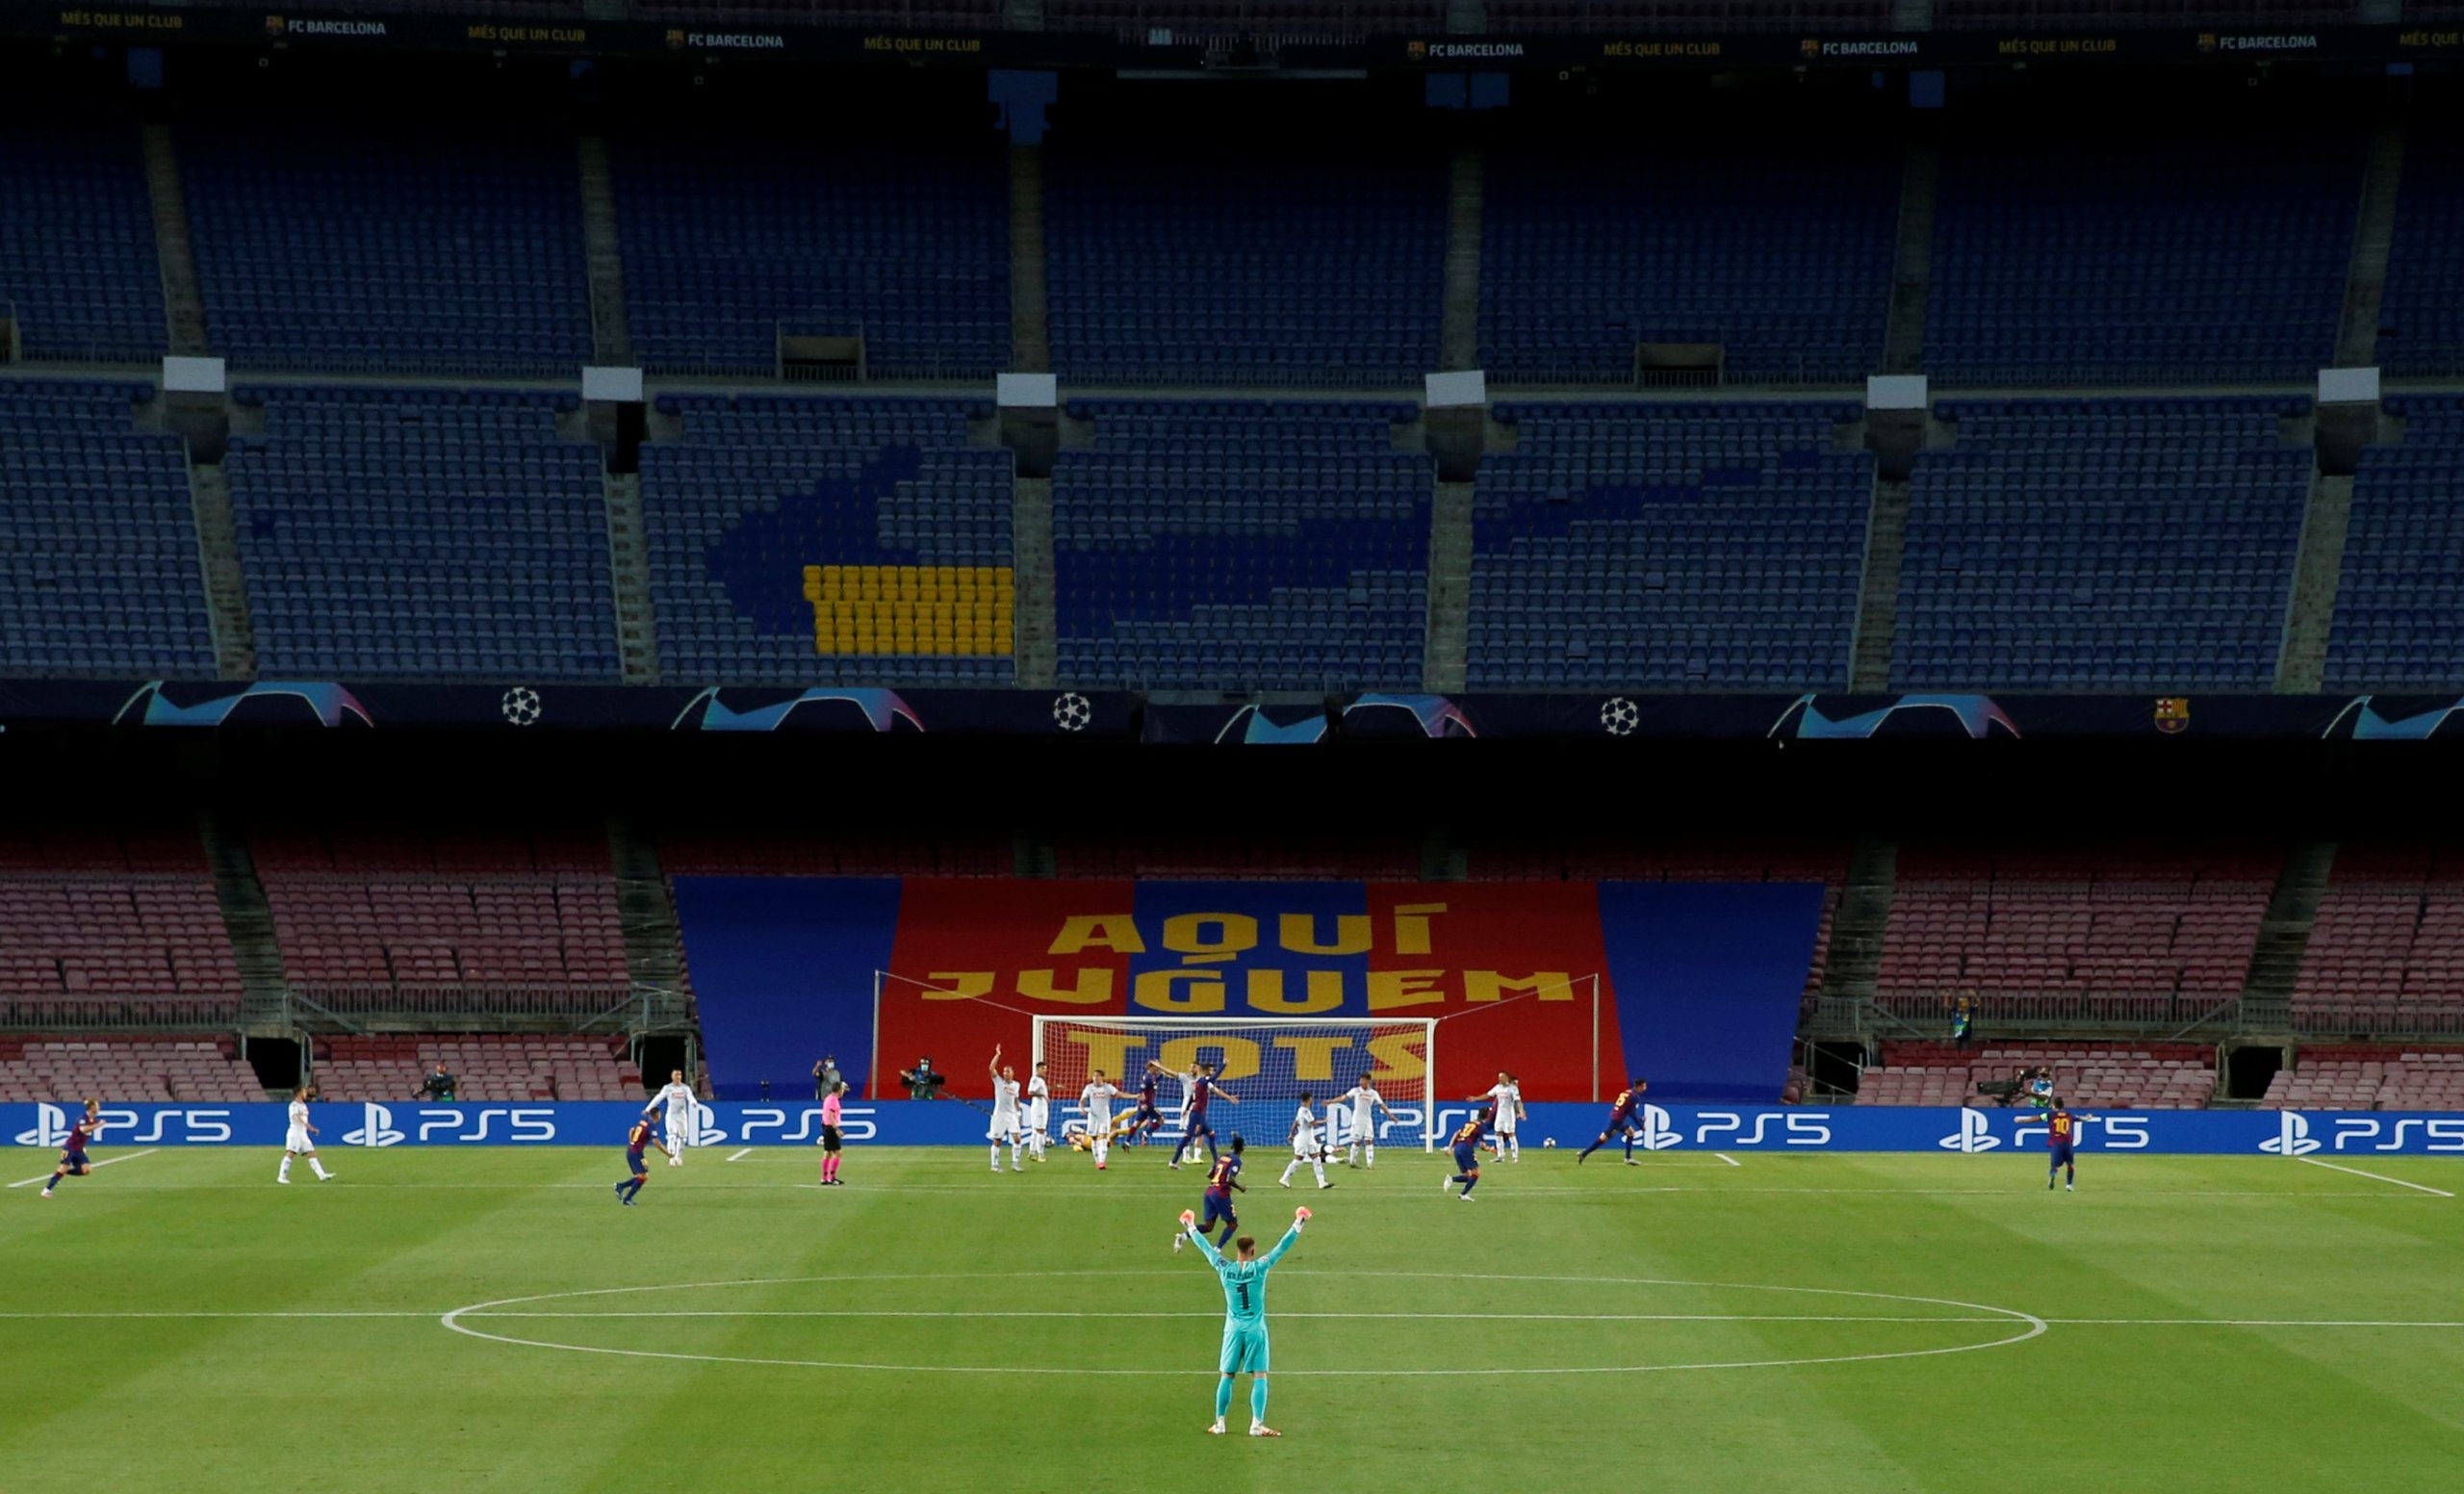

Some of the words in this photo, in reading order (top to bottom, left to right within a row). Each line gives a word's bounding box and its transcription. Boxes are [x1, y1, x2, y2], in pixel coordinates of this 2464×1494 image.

[62, 10, 91, 26] MÉS
[94, 13, 121, 28] QUE
[125, 14, 144, 27] UN
[147, 14, 183, 29] CLUB
[289, 20, 305, 34] FC
[307, 21, 386, 36] BARCELONA
[468, 24, 497, 39] MÉS
[500, 27, 526, 41] QUE
[529, 28, 549, 41] UN
[552, 28, 585, 42] CLUB
[688, 34, 704, 46] FC
[706, 35, 783, 48] BARCELONA
[2400, 32, 2428, 46] MÉS
[2431, 33, 2459, 47] QUE
[864, 35, 892, 50] MÉS
[895, 38, 922, 52] QUE
[925, 39, 943, 51] UN
[947, 39, 981, 52] CLUB
[1429, 44, 1445, 57] FC
[1447, 43, 1524, 57] BARCELONA
[1604, 40, 1631, 56] MÉS
[1635, 43, 1661, 57] QUE
[1665, 43, 1682, 56] UN
[1686, 42, 1720, 56] CLUB
[1823, 42, 1838, 55] FC
[1840, 41, 1917, 55] BARCELONA
[1999, 38, 2027, 54] MÉS
[2030, 40, 2057, 55] QUE
[2060, 39, 2079, 53] UN
[2082, 39, 2116, 52] CLUB
[2220, 37, 2236, 49] FC
[2238, 36, 2317, 49] BARCELONA
[1047, 902, 1447, 965] AQUÍ
[921, 968, 1574, 1013] JUGUEM
[1067, 1031, 1426, 1081] TOTS
[93, 1110, 231, 1142] PS5
[420, 1109, 555, 1141] PS5
[741, 1108, 877, 1141] PS5
[1697, 1113, 1831, 1145] PS5
[2053, 1117, 2069, 1135] 10
[1237, 1283, 1249, 1310] 1
